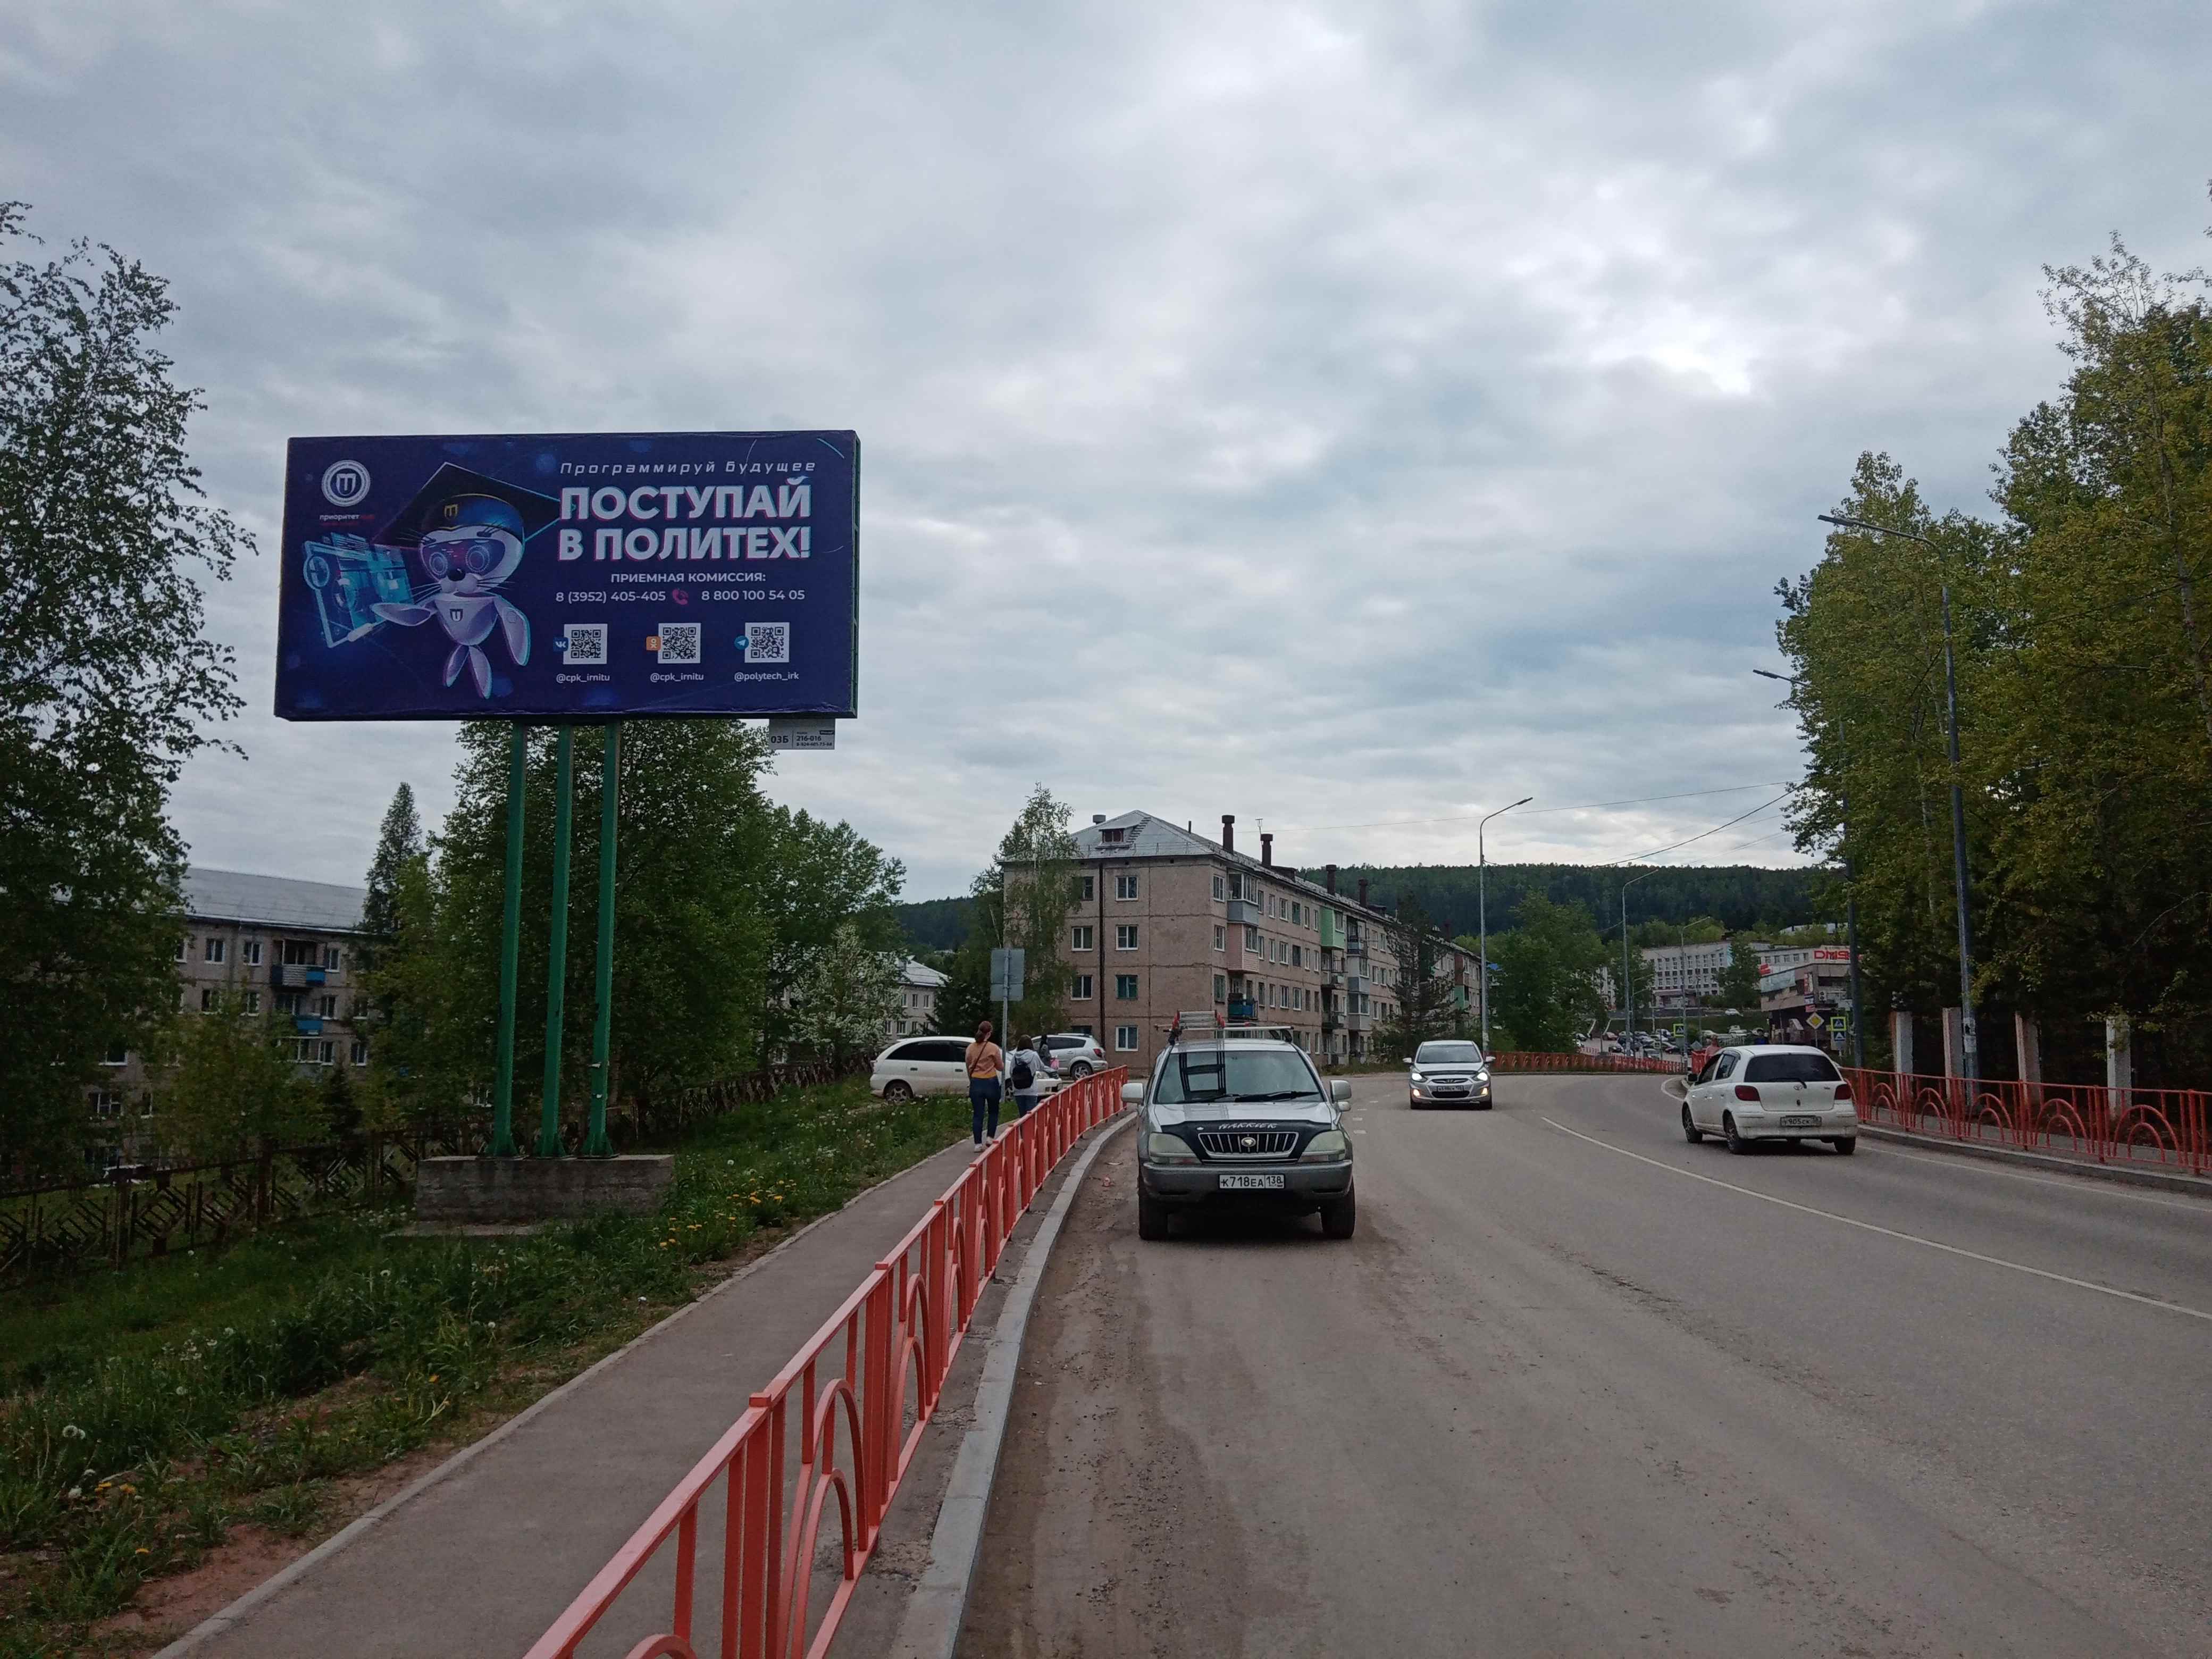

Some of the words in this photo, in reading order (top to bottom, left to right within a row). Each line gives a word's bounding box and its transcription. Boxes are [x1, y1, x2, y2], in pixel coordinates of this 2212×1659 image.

[560, 461, 716, 476] Программируй
[560, 476, 811, 521] ПОСТУПАЙ
[558, 529, 584, 560] В
[594, 526, 811, 561] ПОЛИТЕХ!
[611, 573, 684, 583] ПРИЕМНАЯ
[688, 572, 766, 582] КОМИССИЯ:
[556, 592, 564, 602] 8
[568, 591, 607, 604] (3952)
[610, 591, 666, 601] 405-405
[701, 591, 710, 600] 8
[714, 590, 739, 600] 800
[742, 590, 765, 600] 100
[768, 590, 785, 600] 54
[789, 590, 805, 600] 05
[556, 673, 610, 683] @cpk_irnitu
[650, 673, 704, 683] @cpk_irnitu
[734, 672, 799, 682] @polytech_irk
